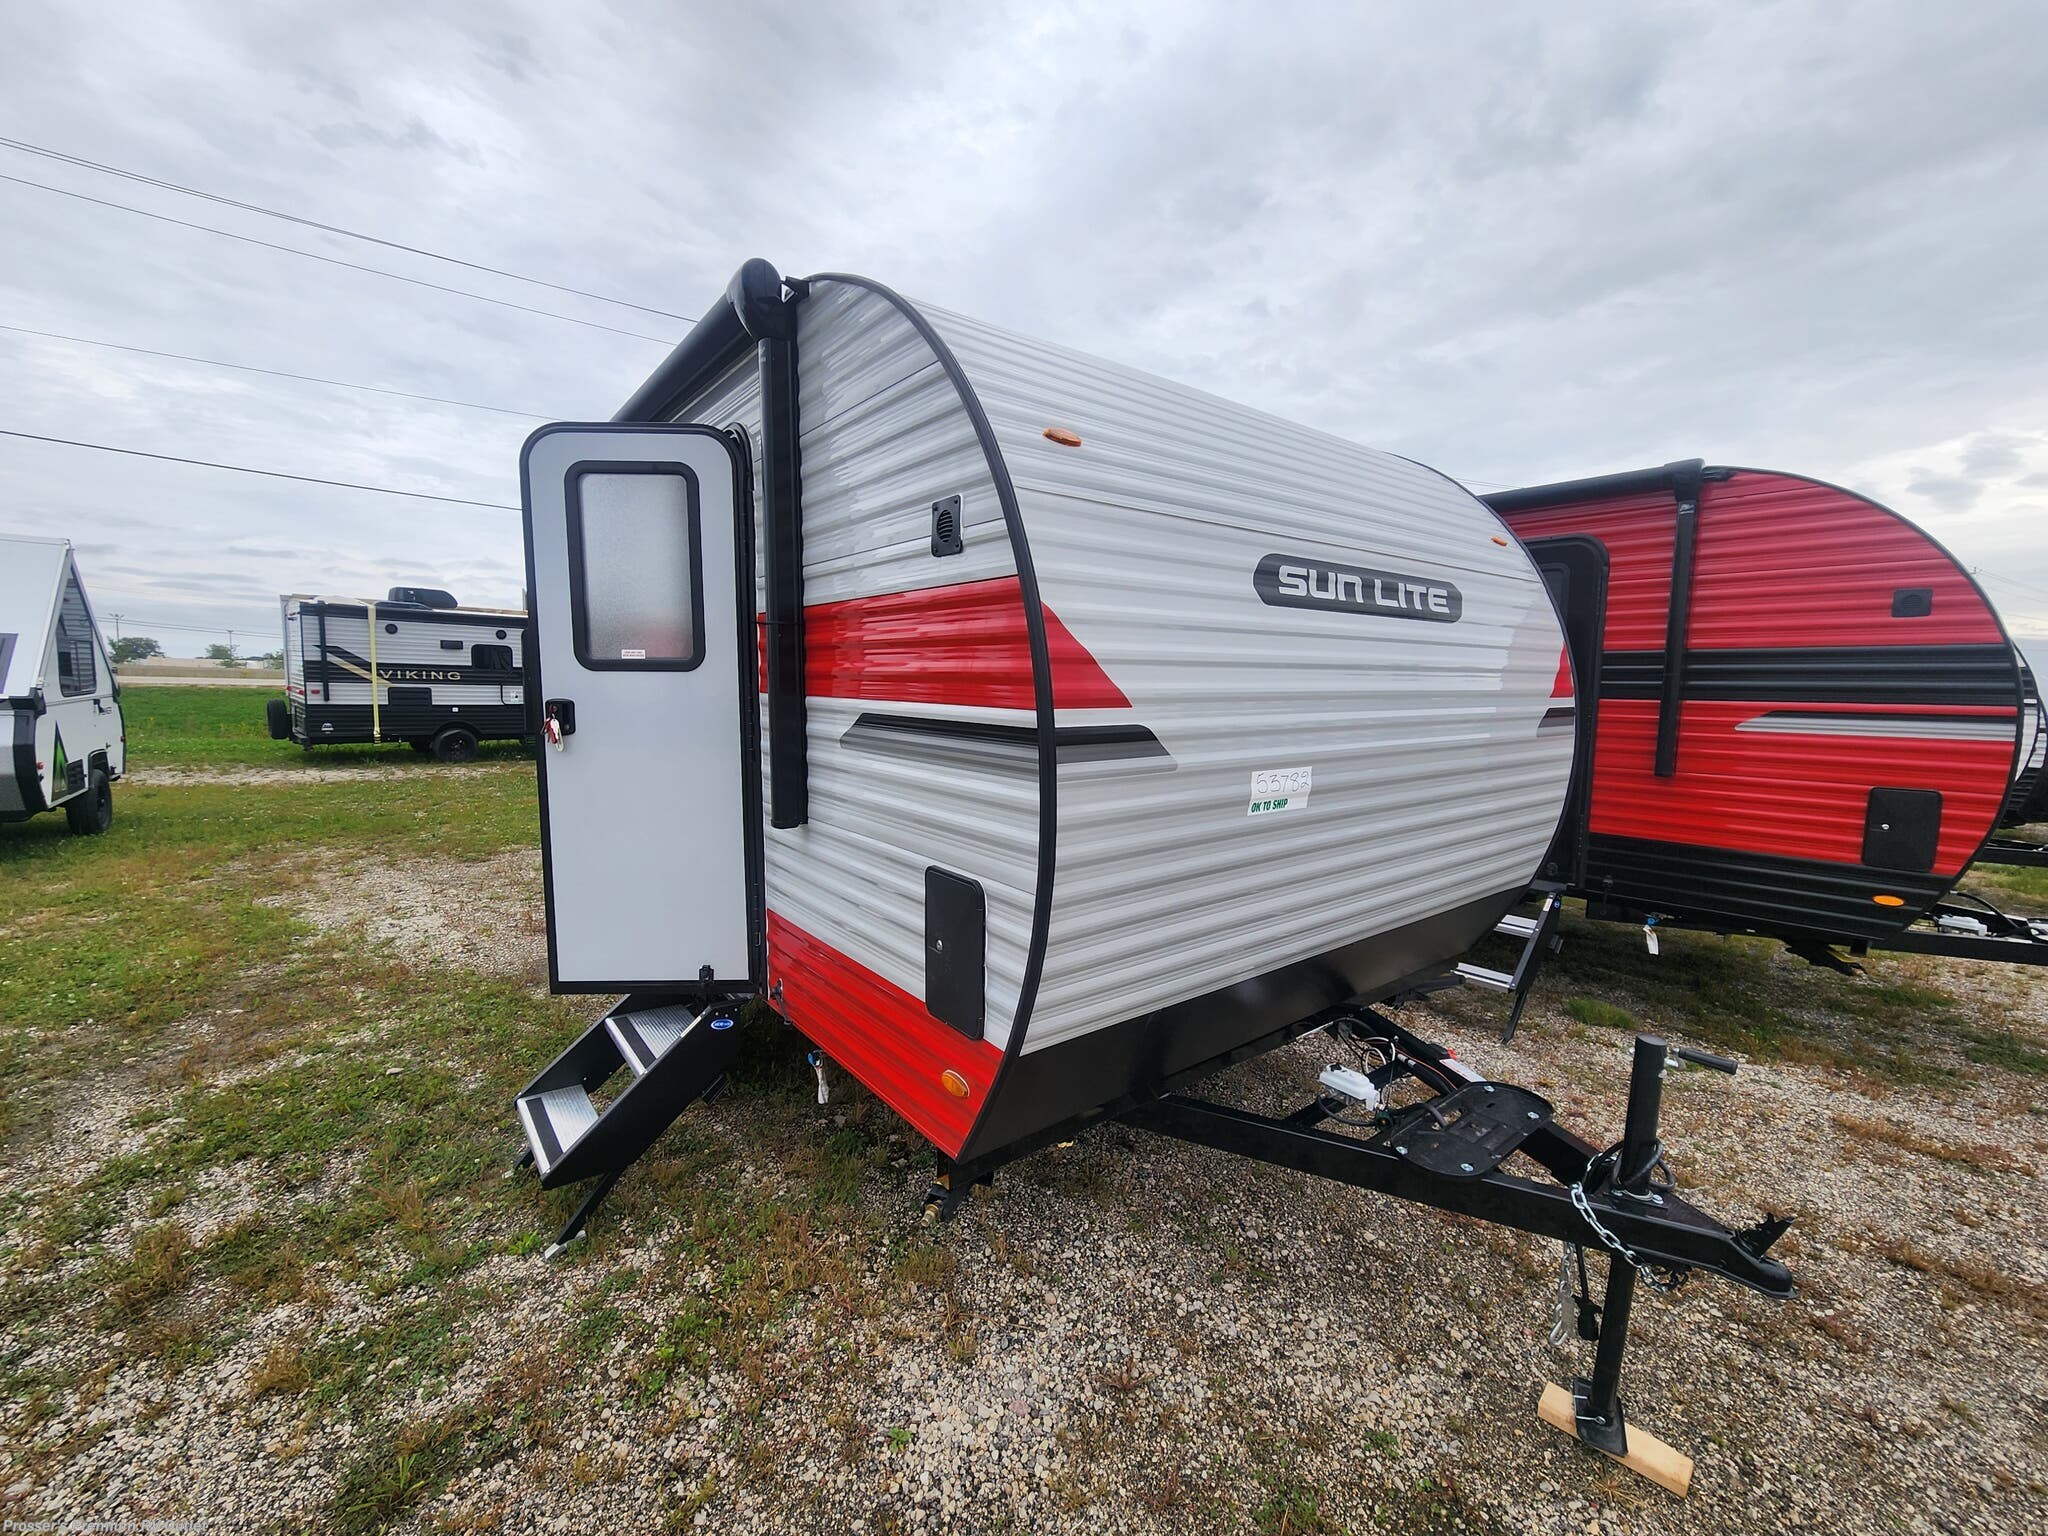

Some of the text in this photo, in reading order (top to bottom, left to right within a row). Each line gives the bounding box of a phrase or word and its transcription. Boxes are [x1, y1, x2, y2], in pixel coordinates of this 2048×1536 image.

[1278, 565, 1451, 614] SUN LITE
[379, 669, 462, 681] VIKING
[1256, 770, 1310, 794] 53782
[1251, 798, 1289, 813] OK TO SHIP
